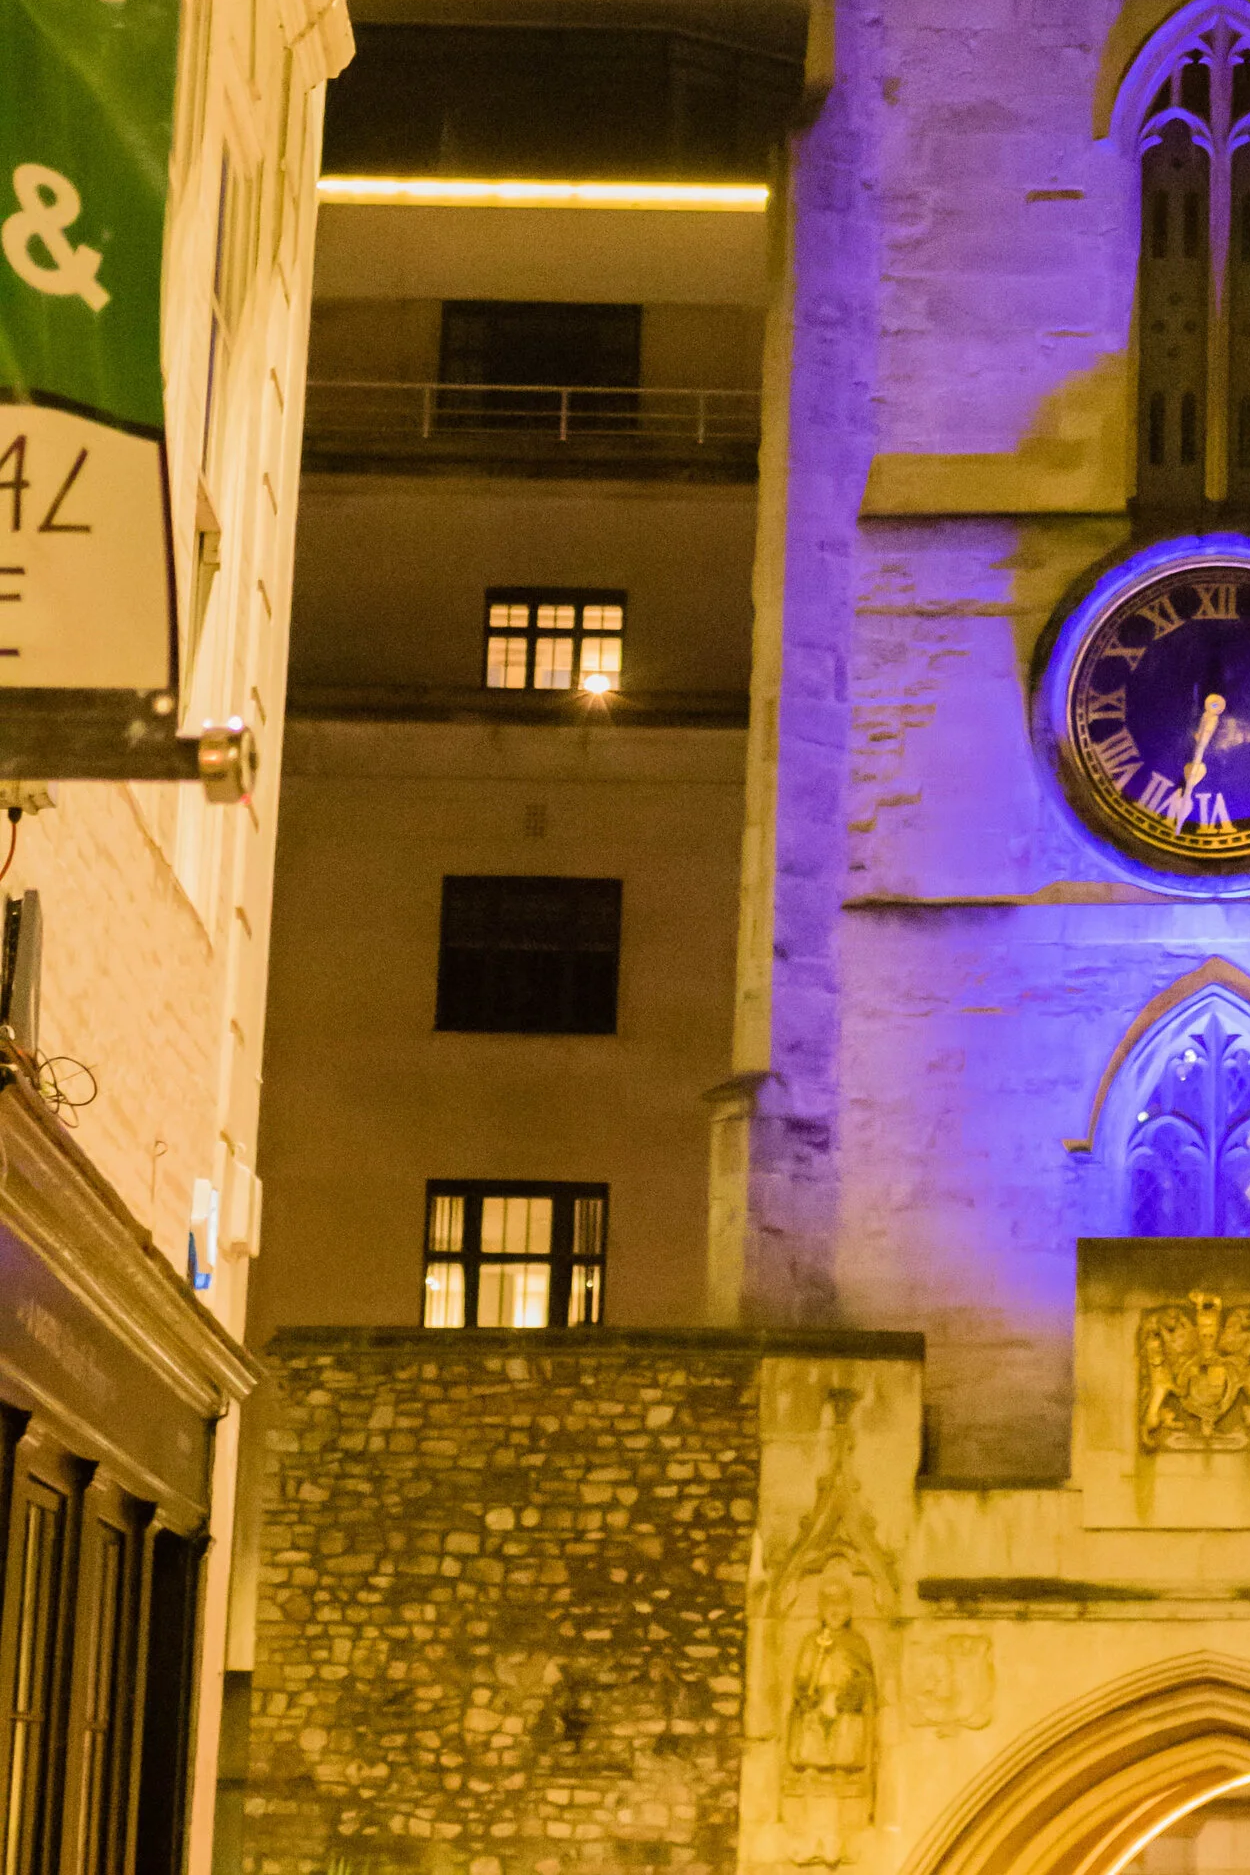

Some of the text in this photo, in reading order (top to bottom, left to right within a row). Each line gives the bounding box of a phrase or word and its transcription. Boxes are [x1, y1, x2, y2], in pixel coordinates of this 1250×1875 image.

[2, 163, 111, 313] &
[1133, 595, 1185, 641] XI
[1192, 582, 1241, 621] XII
[1104, 635, 1147, 671] X
[1088, 685, 1127, 722] IX
[1195, 792, 1238, 835] VI
